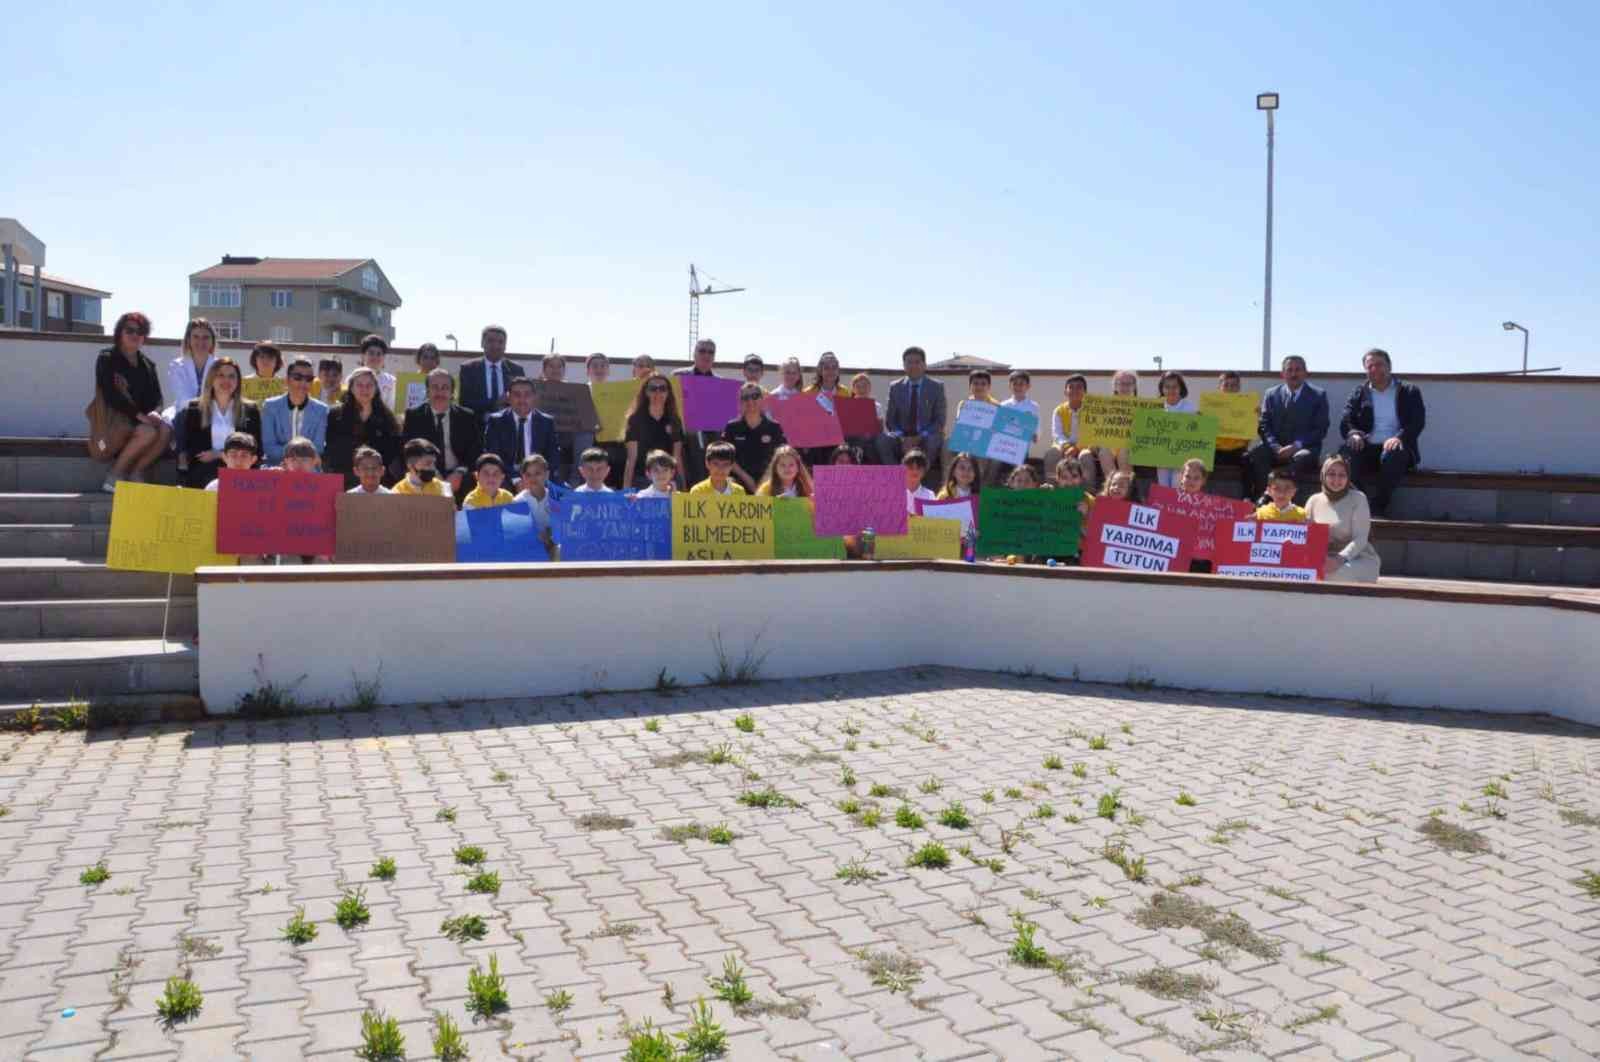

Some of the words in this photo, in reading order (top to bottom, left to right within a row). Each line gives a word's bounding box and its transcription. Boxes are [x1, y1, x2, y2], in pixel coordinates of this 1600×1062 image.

[718, 501, 772, 520] YARDIM
[1134, 508, 1156, 526] İLK
[1105, 528, 1174, 554] YARDIMA
[1264, 528, 1307, 539] YARDIM
[1113, 550, 1165, 571] TUTUN
